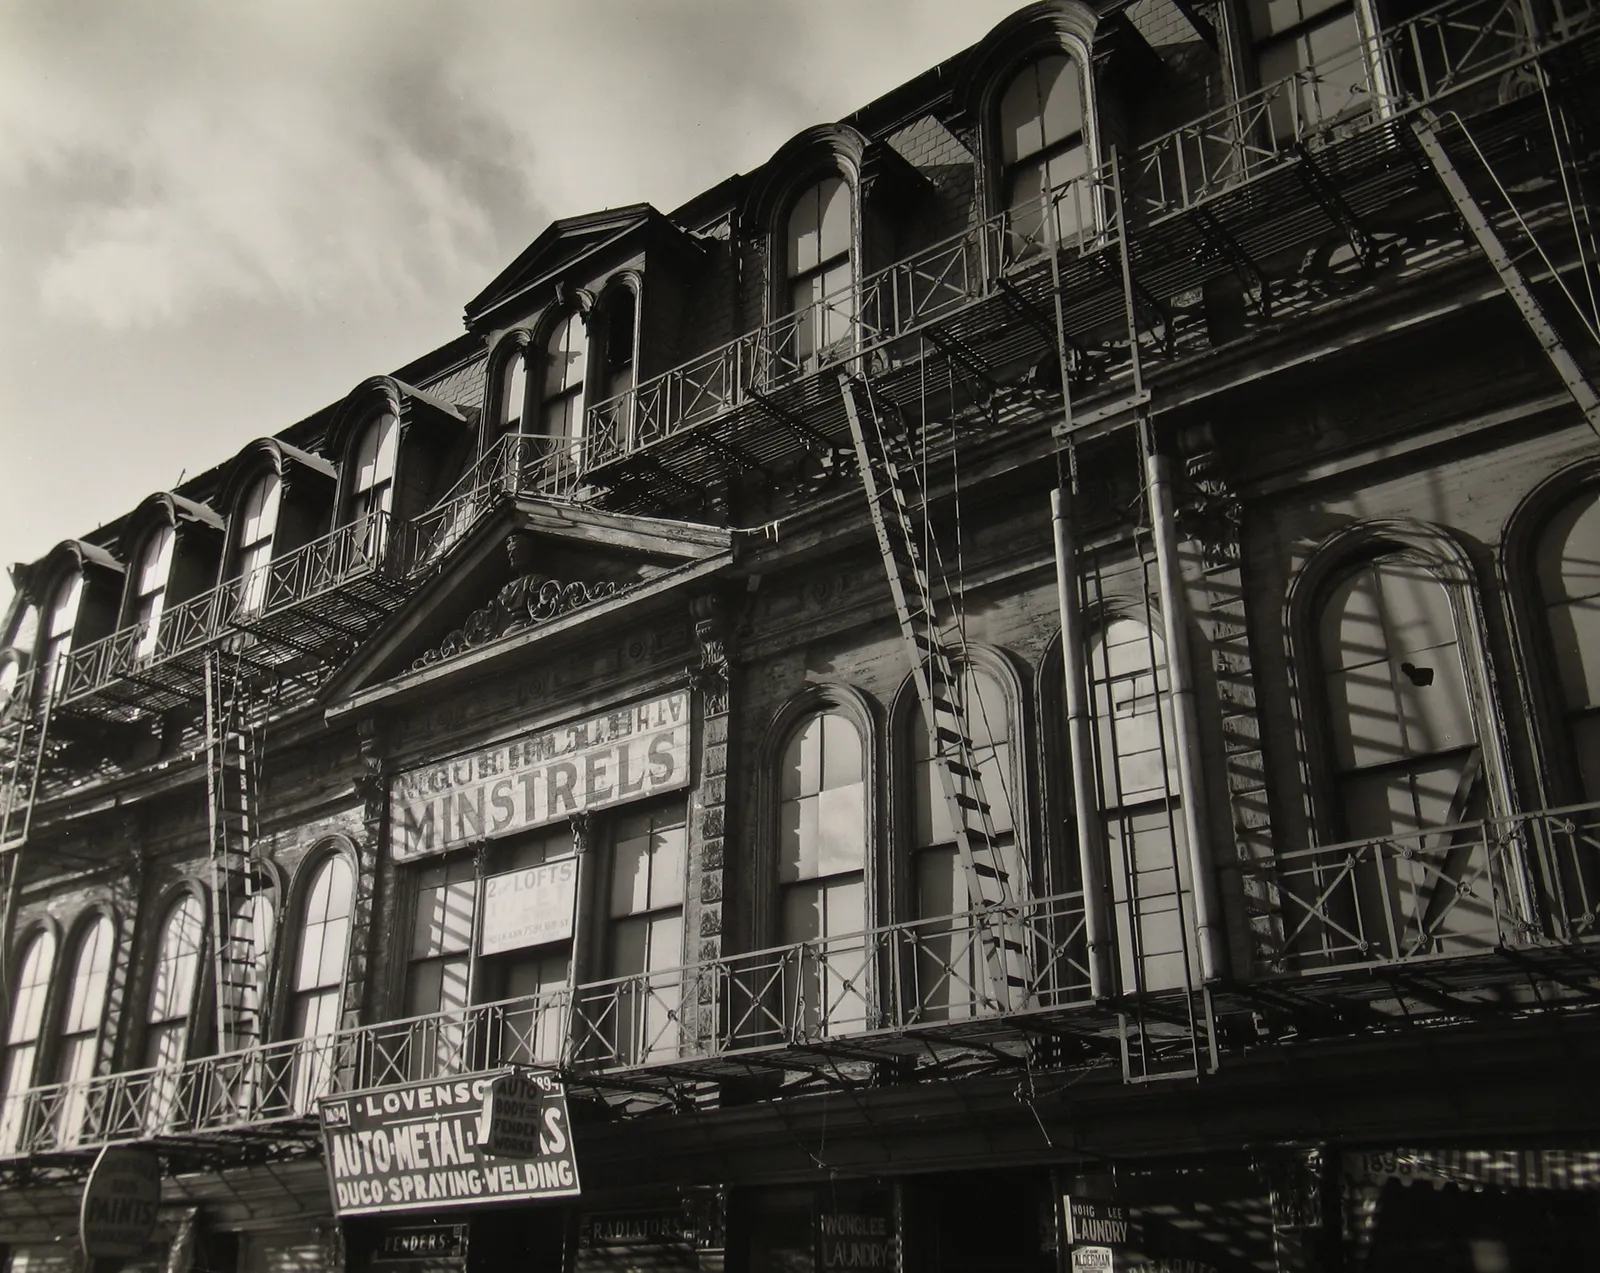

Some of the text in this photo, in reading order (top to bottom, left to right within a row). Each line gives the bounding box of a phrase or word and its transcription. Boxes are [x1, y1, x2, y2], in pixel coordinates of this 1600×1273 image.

[403, 733, 675, 855] MINSTRELS
[487, 880, 497, 898] 2
[513, 863, 572, 893] LOFTS
[497, 1078, 537, 1099] AUTO
[496, 1098, 526, 1117] BODY
[494, 1119, 537, 1137] FENDER
[494, 1137, 534, 1153] WORKS
[88, 1196, 153, 1225] PAINTS
[1107, 1207, 1123, 1220] LEE
[593, 1217, 681, 1240] RADIATORS
[1073, 1216, 1127, 1243] LAUNDRY
[384, 1234, 446, 1252] FENDERS
[822, 1241, 888, 1267] LAUNDRY
[1074, 1254, 1110, 1267] ALDERMAN
